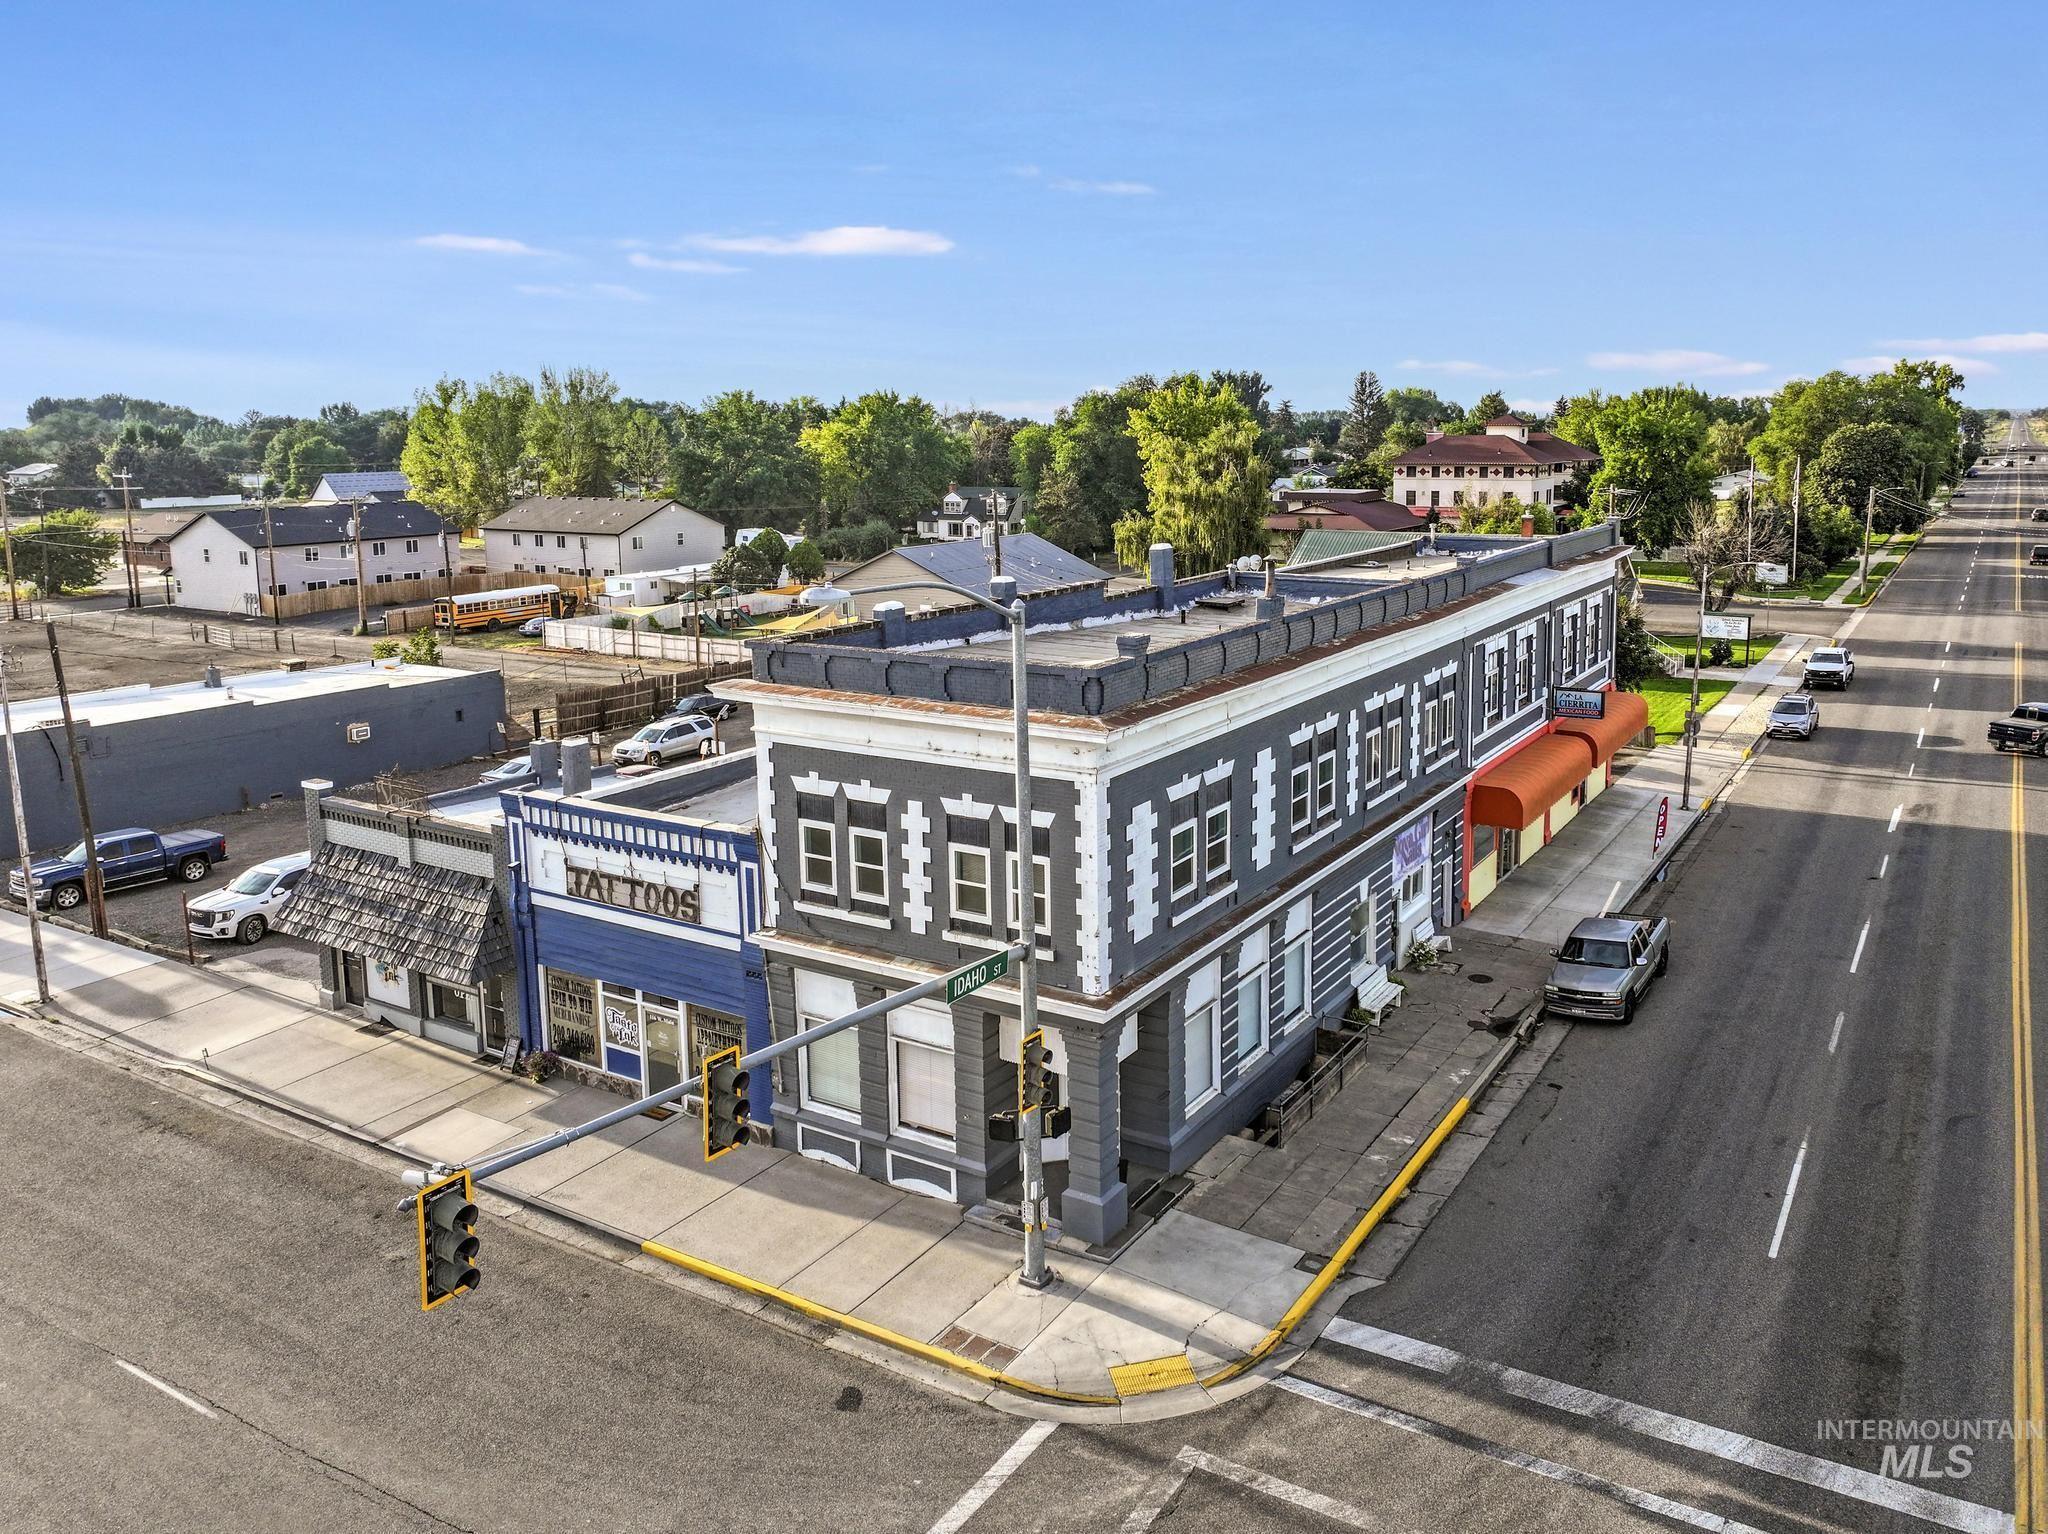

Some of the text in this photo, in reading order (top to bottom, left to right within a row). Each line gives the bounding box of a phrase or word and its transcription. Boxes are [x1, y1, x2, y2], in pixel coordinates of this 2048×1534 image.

[1559, 699, 1599, 710] CIERRITA
[1655, 804, 1666, 848] OPEN
[566, 867, 700, 922] TATTOOS
[571, 981, 593, 998] TATTOOS
[953, 962, 1002, 997] IDAHO ST
[606, 1006, 637, 1033] Taste
[696, 1013, 743, 1037] CUSTOM TATTOOS
